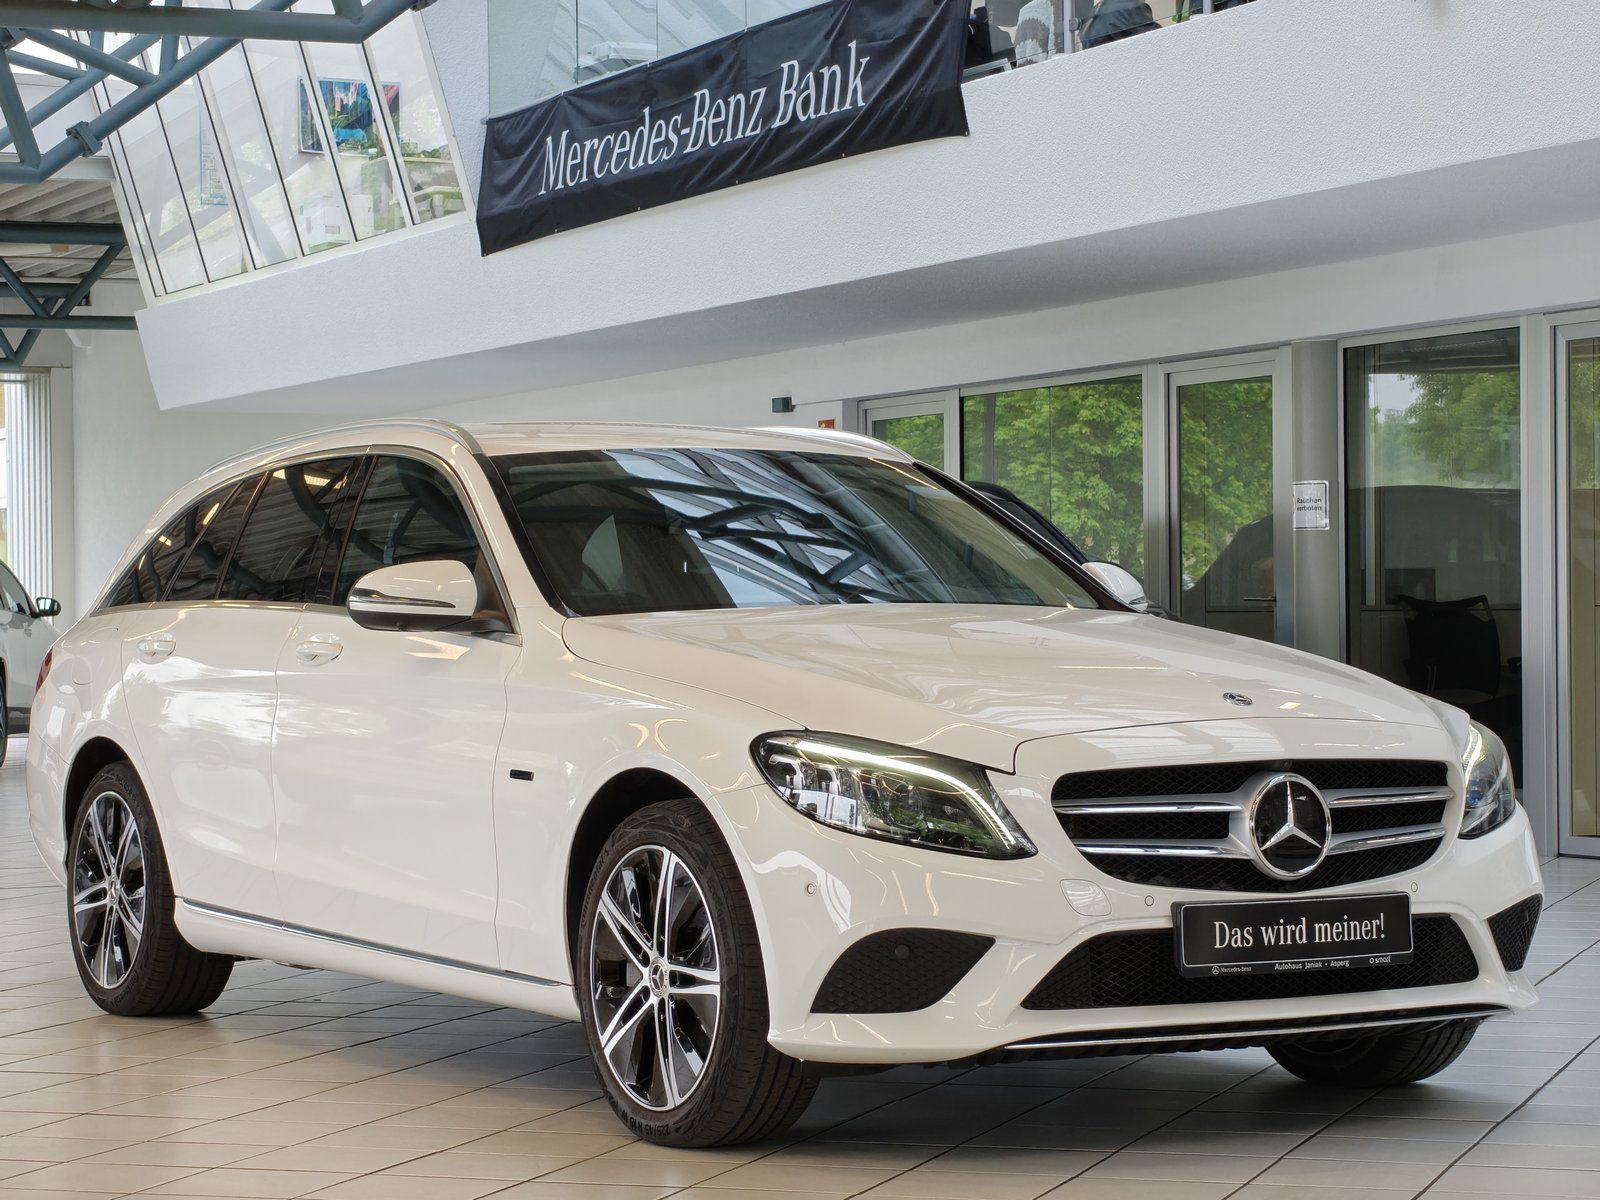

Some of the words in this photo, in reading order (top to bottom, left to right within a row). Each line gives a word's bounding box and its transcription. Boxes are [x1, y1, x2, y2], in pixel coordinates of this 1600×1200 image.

[538, 87, 767, 196] Mercedes-Benz
[771, 40, 871, 129] Bank
[1213, 920, 1253, 949] Das
[1260, 917, 1307, 946] wird
[1313, 912, 1386, 944] meiner!
[1274, 962, 1303, 971] Autohaus
[1304, 960, 1323, 970] Janiak
[1329, 960, 1350, 968] Asperg
[1374, 955, 1391, 964] smart
